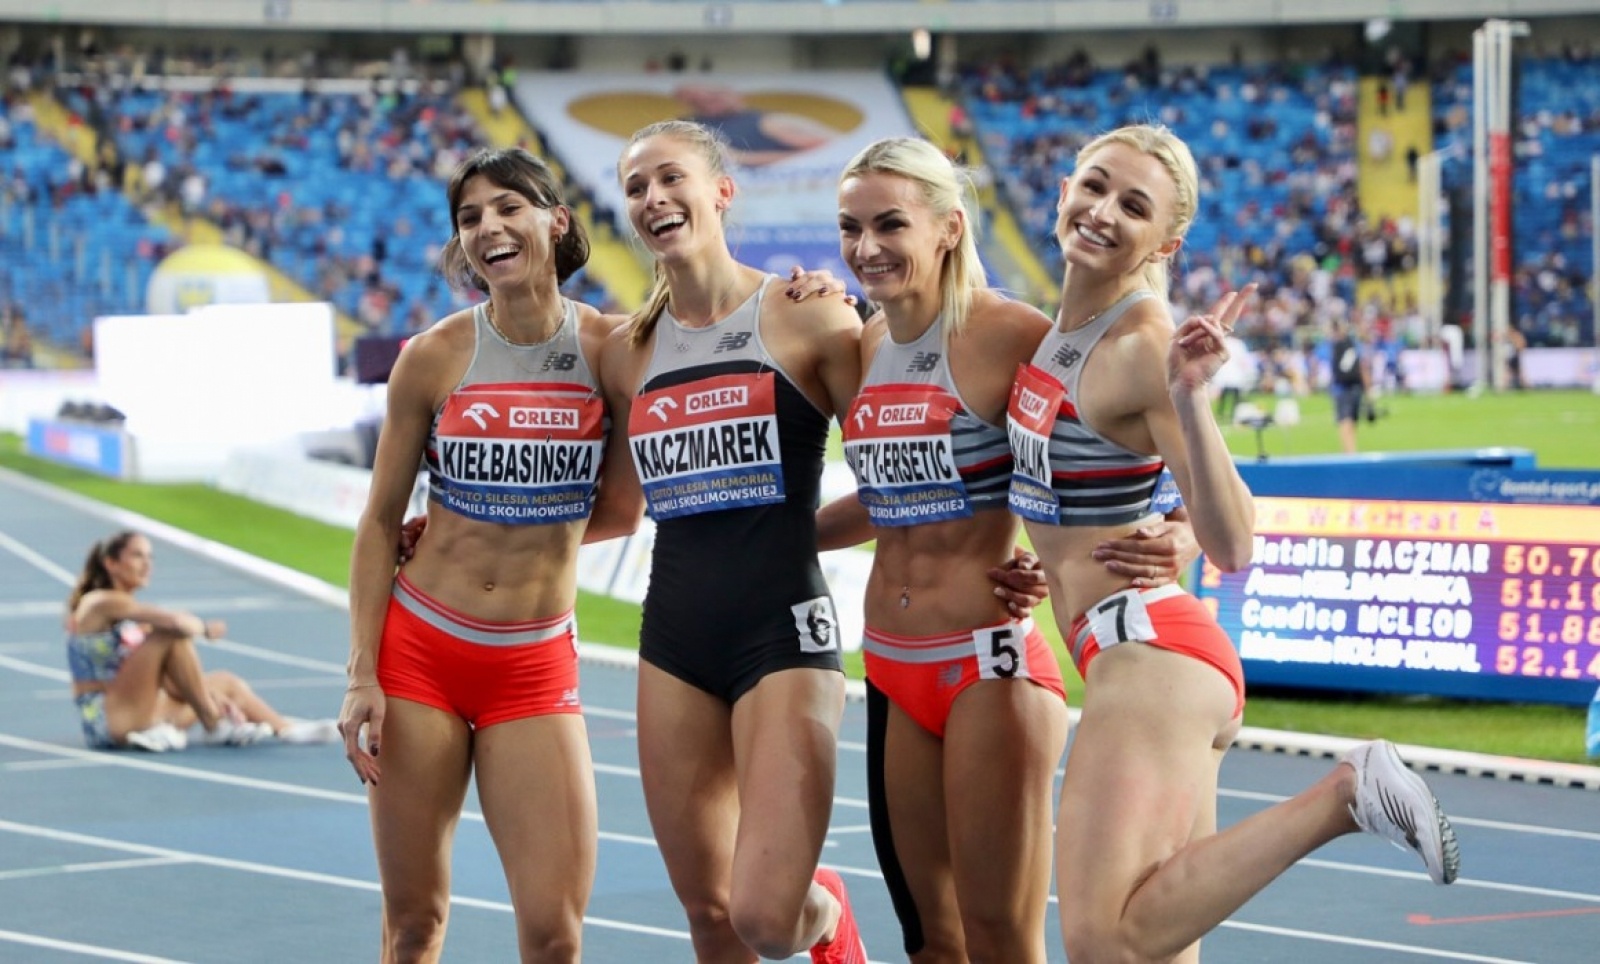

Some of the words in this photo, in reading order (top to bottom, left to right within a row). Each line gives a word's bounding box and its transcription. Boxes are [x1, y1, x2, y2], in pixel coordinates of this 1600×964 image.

[689, 389, 743, 410] ORLEN
[881, 406, 925, 423] ORLEN
[514, 410, 575, 426] ORLEN
[443, 435, 593, 484] KIEŁBASIŃSKA
[634, 420, 774, 479] KACZMAREK
[486, 492, 529, 505] SILESIA
[675, 481, 709, 495] SILESIA
[711, 473, 776, 489] MEMORIAŁ
[679, 485, 777, 509] SKOLIMOWSKIEJ
[448, 495, 485, 515] KAMILI
[489, 502, 585, 518] SKOLIMOWSKIEJ
[1354, 539, 1491, 575] KACZMAR
[807, 603, 831, 647] 6
[1098, 595, 1129, 644] 7
[1357, 604, 1473, 640] MCLEOD
[991, 628, 1020, 679] 5
